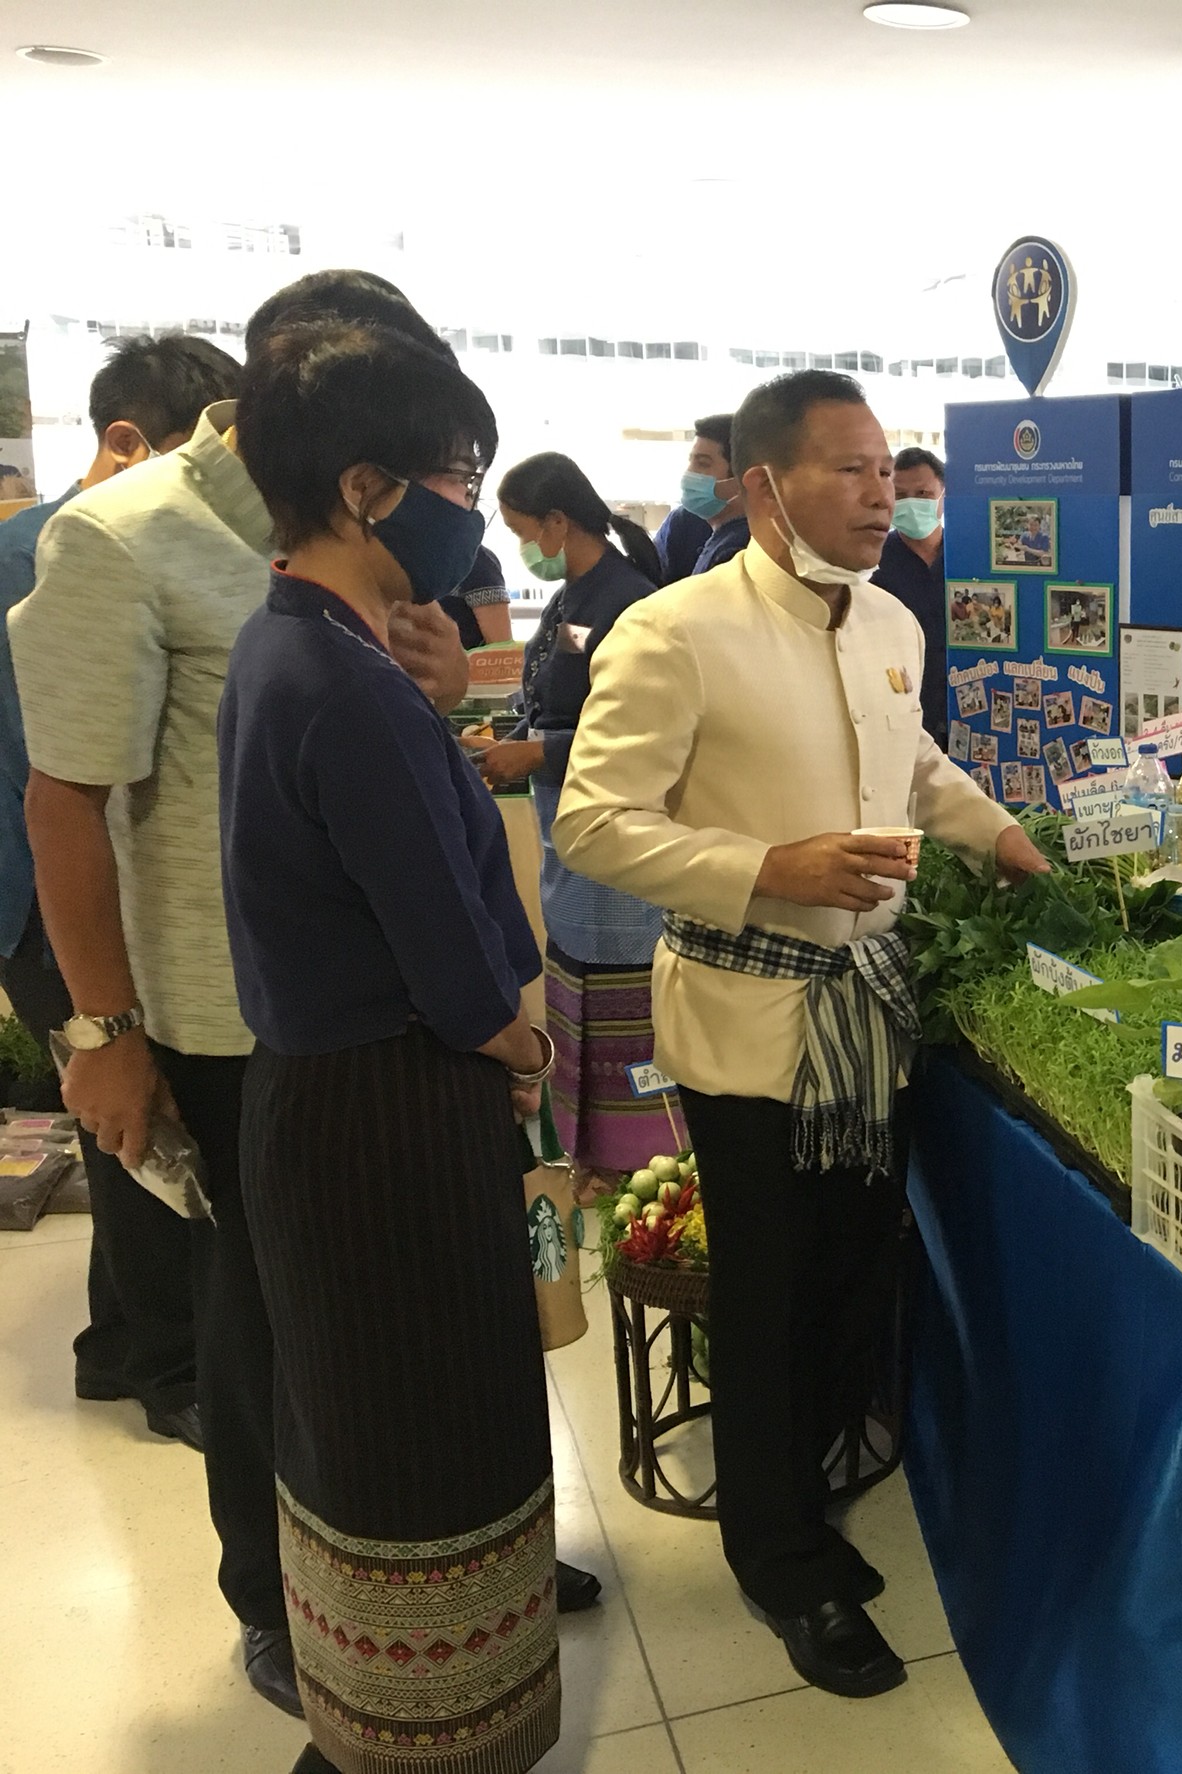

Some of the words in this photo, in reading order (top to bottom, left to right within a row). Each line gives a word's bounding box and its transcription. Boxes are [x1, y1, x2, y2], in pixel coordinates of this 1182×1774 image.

[975, 475, 1007, 486] Community
[1009, 474, 1046, 485] Development
[1048, 474, 1083, 485] Department
[1003, 655, 1058, 681] แลกเปลี่ยน
[1069, 820, 1153, 851] ผักไชยา
